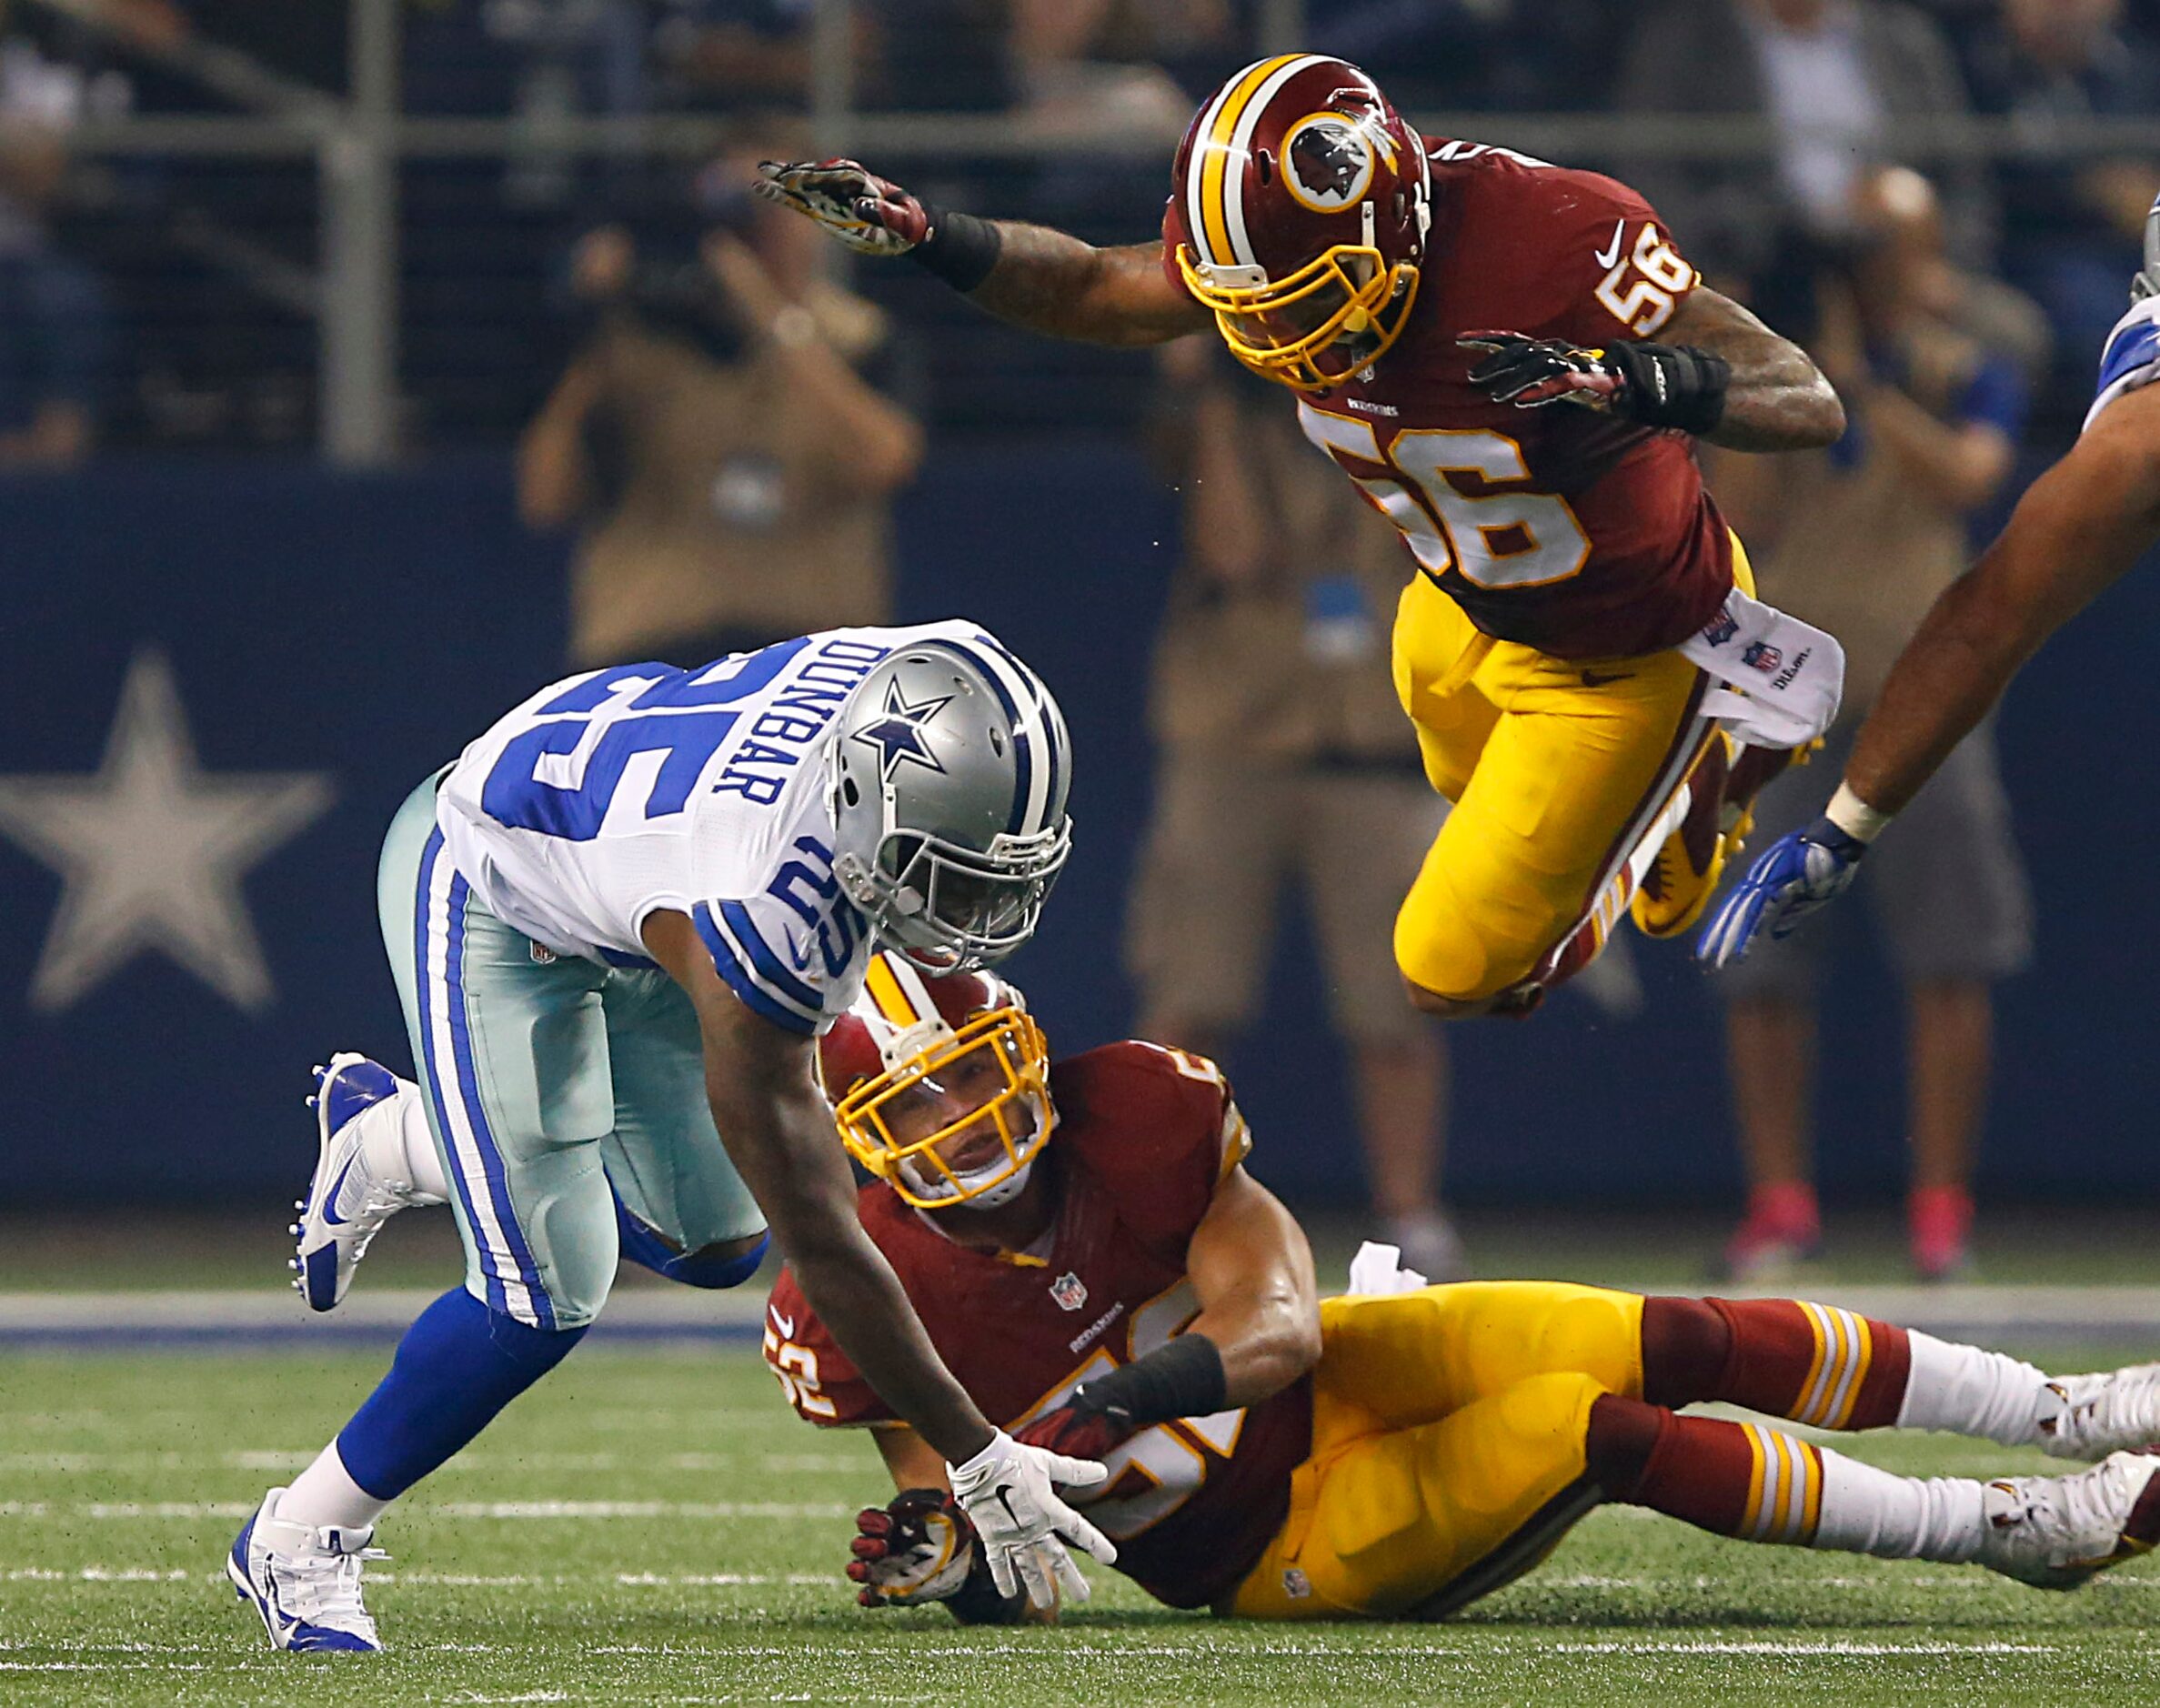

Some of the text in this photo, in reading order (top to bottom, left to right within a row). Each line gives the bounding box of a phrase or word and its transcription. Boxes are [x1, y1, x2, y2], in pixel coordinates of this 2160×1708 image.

[1594, 221, 1693, 337] 56
[1295, 395, 1592, 589] 56
[481, 636, 812, 842] 25
[713, 639, 891, 805] DUNBAR
[766, 836, 868, 979] 25
[762, 1324, 838, 1418] 52
[1069, 1301, 1124, 1353] REDSKINS
